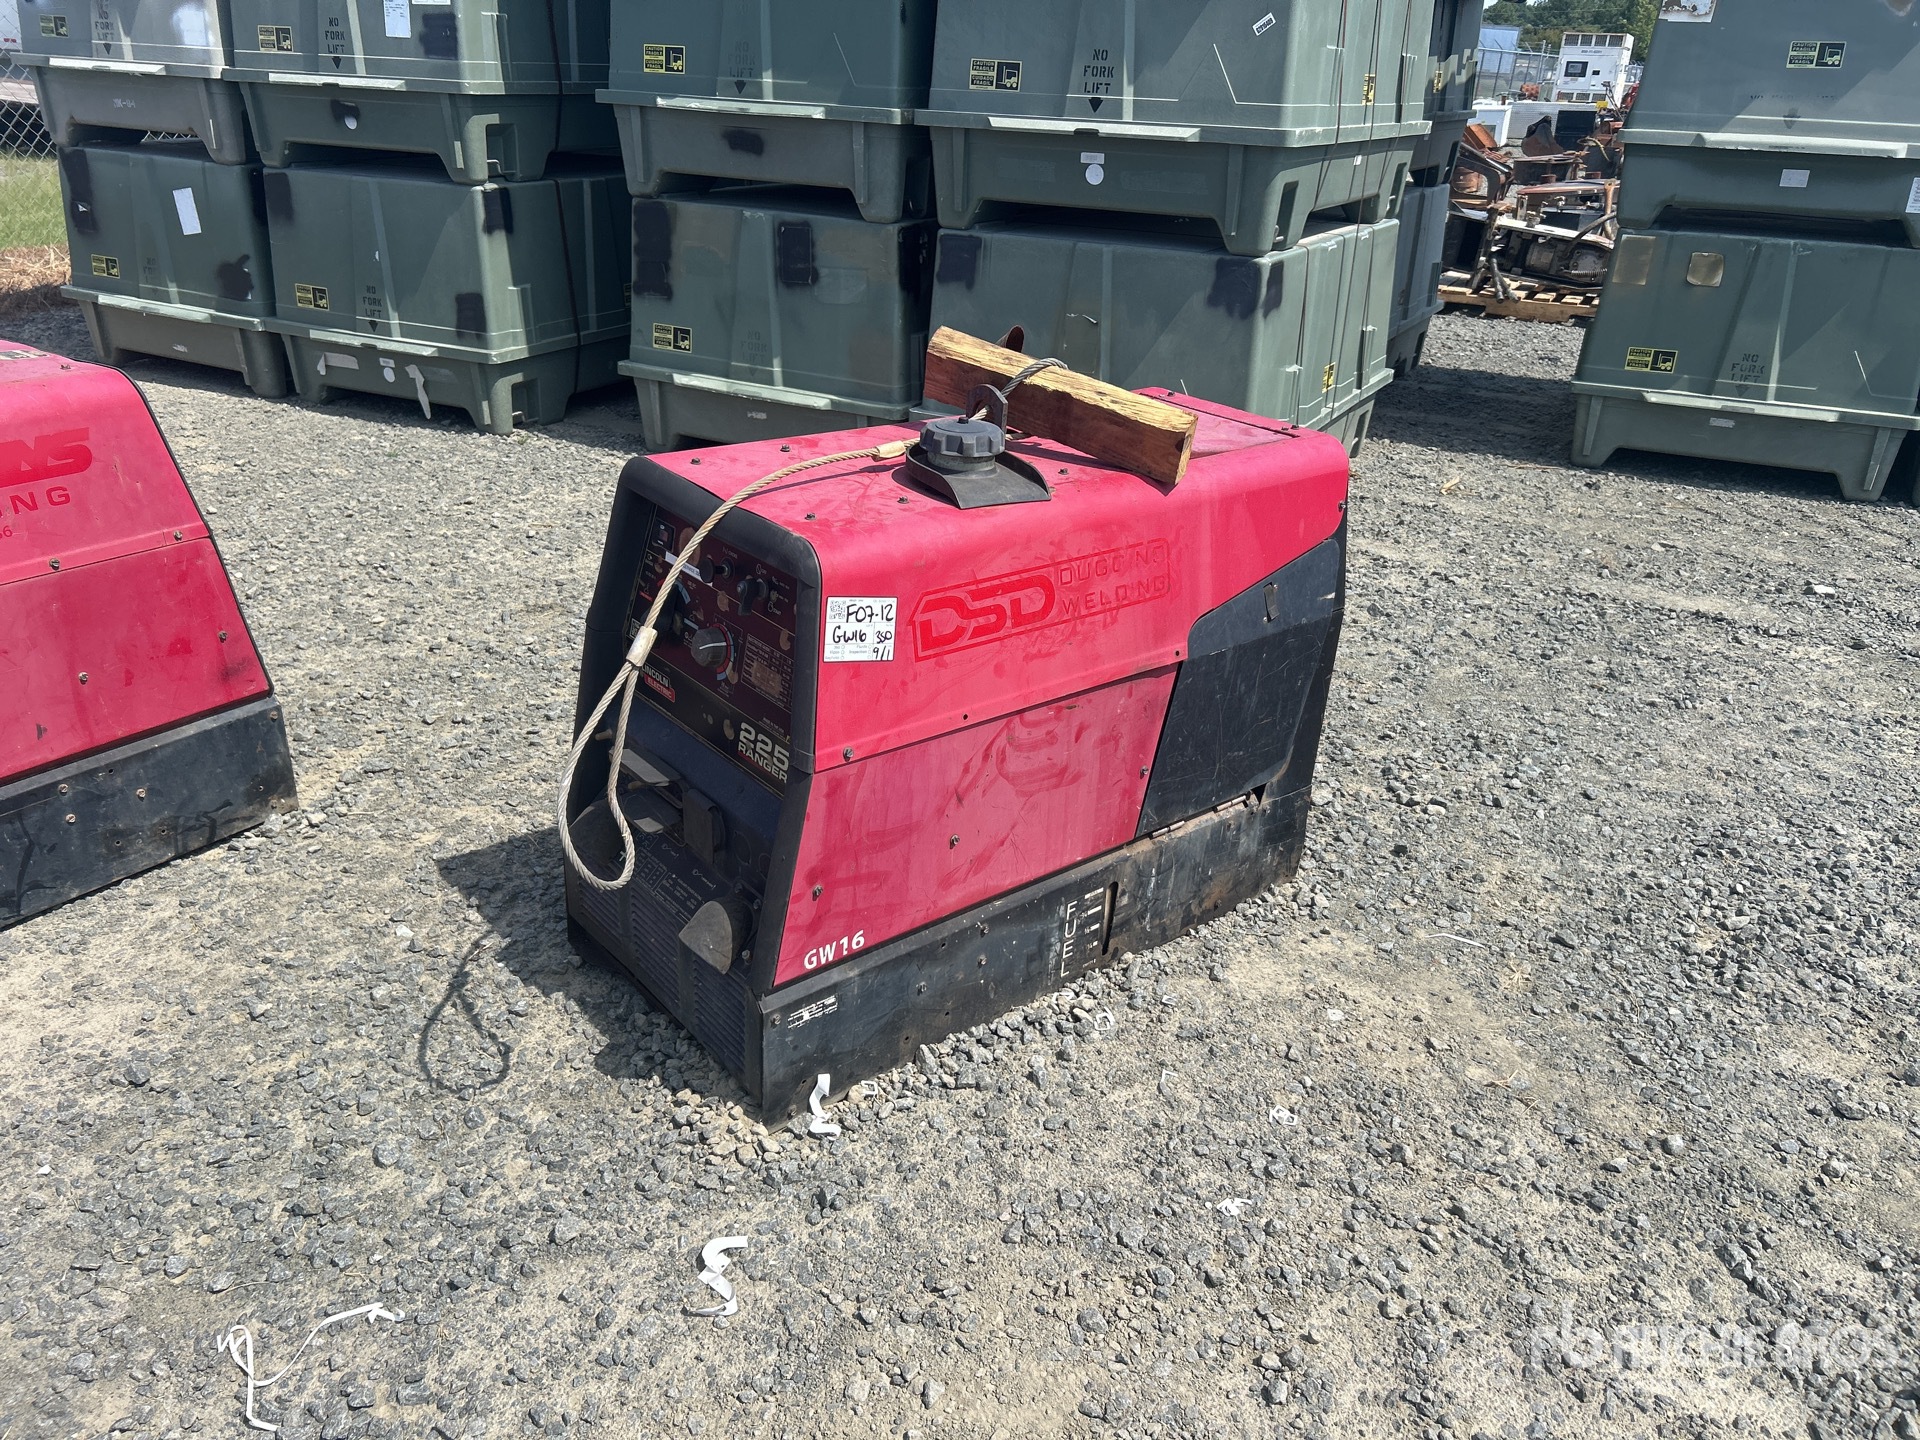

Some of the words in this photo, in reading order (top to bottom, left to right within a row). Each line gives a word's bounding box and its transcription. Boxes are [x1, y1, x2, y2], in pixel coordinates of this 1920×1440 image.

[328, 17, 339, 27] NO
[325, 30, 346, 41] FORK
[327, 44, 345, 54] LIFT
[1092, 48, 1108, 61] NO
[729, 67, 754, 78] LIFT
[1083, 65, 1115, 79] FORK
[1083, 81, 1111, 94] LIFT
[366, 285, 376, 294] NO
[362, 296, 383, 308] FORK
[365, 308, 382, 319] LIFT
[1741, 353, 1759, 363] NO
[1731, 373, 1761, 384] LIFT
[846, 603, 894, 623] F07-12
[832, 624, 867, 644] GW16
[873, 645, 890, 661] 9/1
[641, 661, 670, 688] LINCOLN
[647, 677, 673, 699] ELECTRIC
[739, 722, 790, 771] 225
[738, 741, 788, 784] RANGER
[1061, 900, 1078, 978] FUEL
[803, 929, 866, 970] GW16
